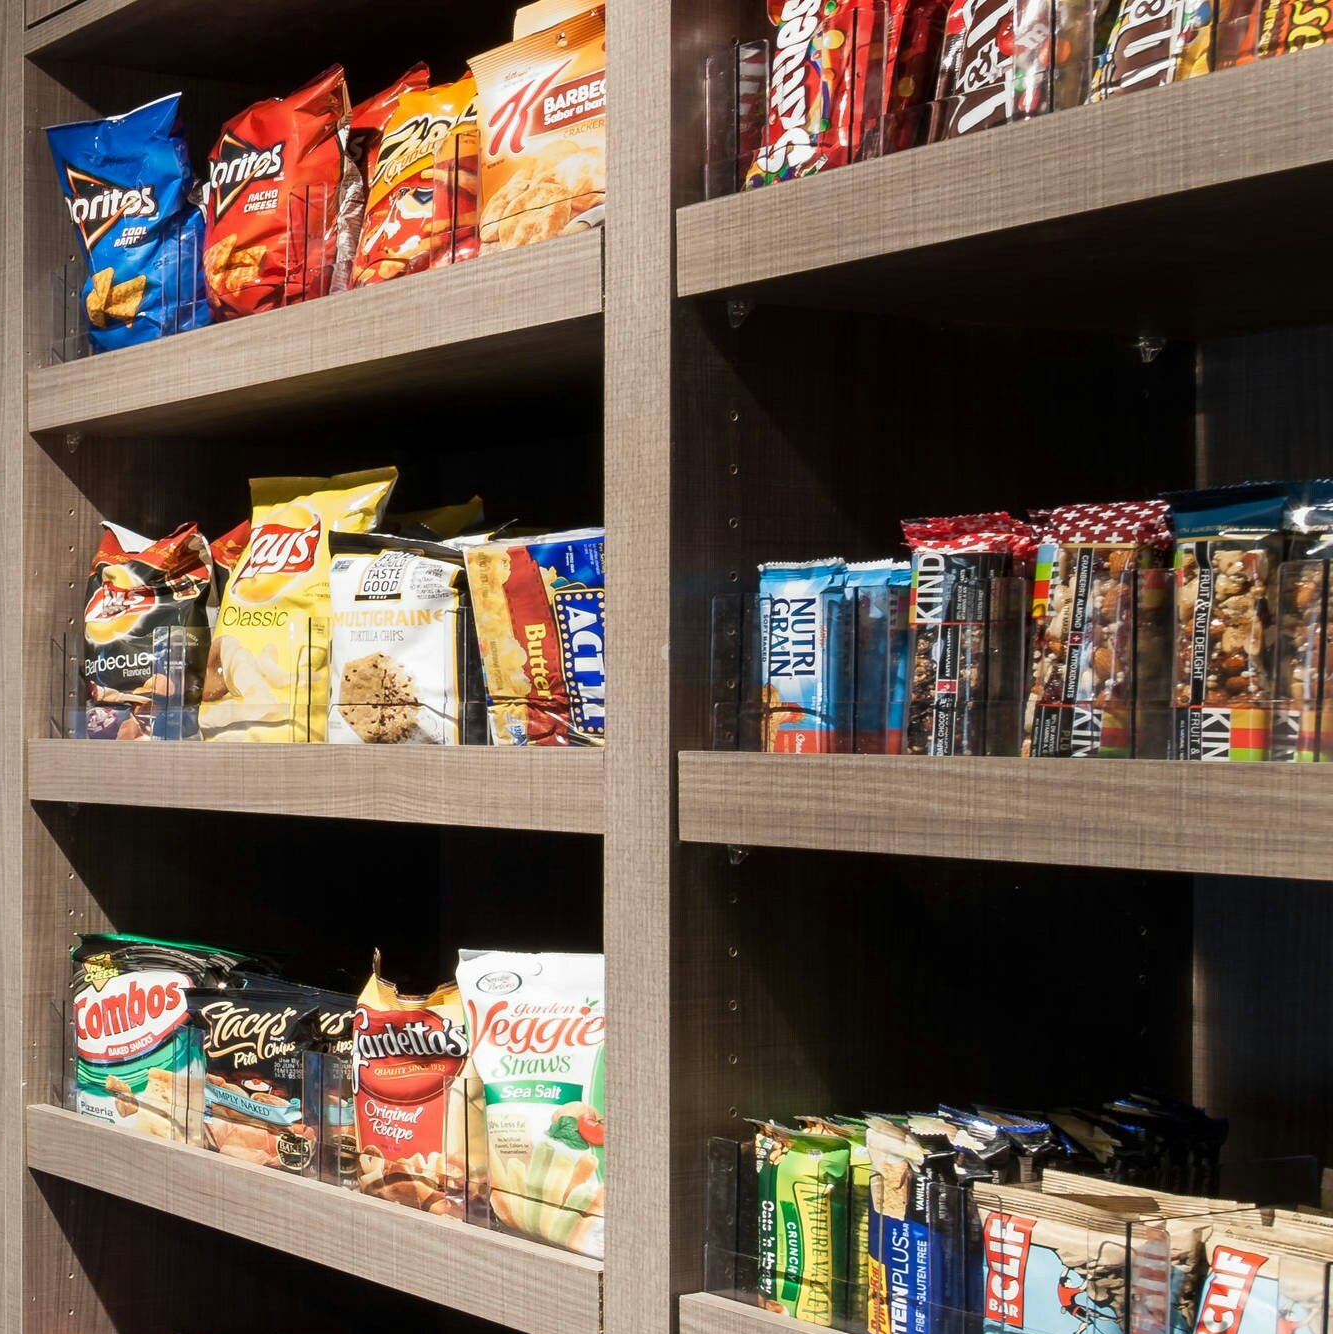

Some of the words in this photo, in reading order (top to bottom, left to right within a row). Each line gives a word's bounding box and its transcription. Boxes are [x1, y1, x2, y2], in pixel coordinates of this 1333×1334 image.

[67, 187, 156, 224] oritos
[243, 199, 277, 213] CHEESE
[247, 188, 278, 203] NACHO
[363, 580, 400, 592] GOOD
[367, 568, 402, 580] TASTE
[915, 551, 946, 624] KIND
[1079, 554, 1090, 598] CRANBERRY
[1198, 568, 1210, 598] FRUIT
[222, 606, 289, 627] Classic
[1074, 598, 1085, 629] ALMOND
[1196, 612, 1206, 637] NUT
[769, 597, 792, 679] GRAIN
[790, 597, 816, 677] NUTRI
[84, 651, 151, 677] Barbecue
[122, 667, 151, 678] Flavored
[524, 622, 553, 701] Butter
[1193, 637, 1206, 681] DELIGHT
[1066, 648, 1080, 699] ANTIOXIDANTS
[1071, 706, 1103, 758] KIN
[1190, 711, 1200, 739] FRUIT
[1201, 708, 1231, 761] KIN
[75, 980, 182, 1041] Combos
[201, 1000, 298, 1060] Stacy's
[468, 999, 605, 1056] Veggie
[107, 1044, 129, 1057] BAKED
[129, 1034, 154, 1054] SNACKS
[234, 1051, 258, 1070] Pita
[264, 1041, 297, 1059] Chips
[374, 1066, 407, 1076] QUALITY
[491, 1054, 572, 1078] Straws
[500, 1085, 531, 1100] Sea
[535, 1084, 561, 1100] Salt
[80, 1100, 114, 1118] Pizzeria
[241, 1099, 271, 1117] NAKED
[364, 1100, 424, 1126] Original
[368, 1117, 414, 1145] Recipe
[786, 1221, 798, 1283] CRUNCHY
[916, 1239, 928, 1265] FREE
[989, 1219, 1026, 1302] CLIF
[1203, 1251, 1254, 1333] CLIF
[988, 1299, 1019, 1319] BAR
